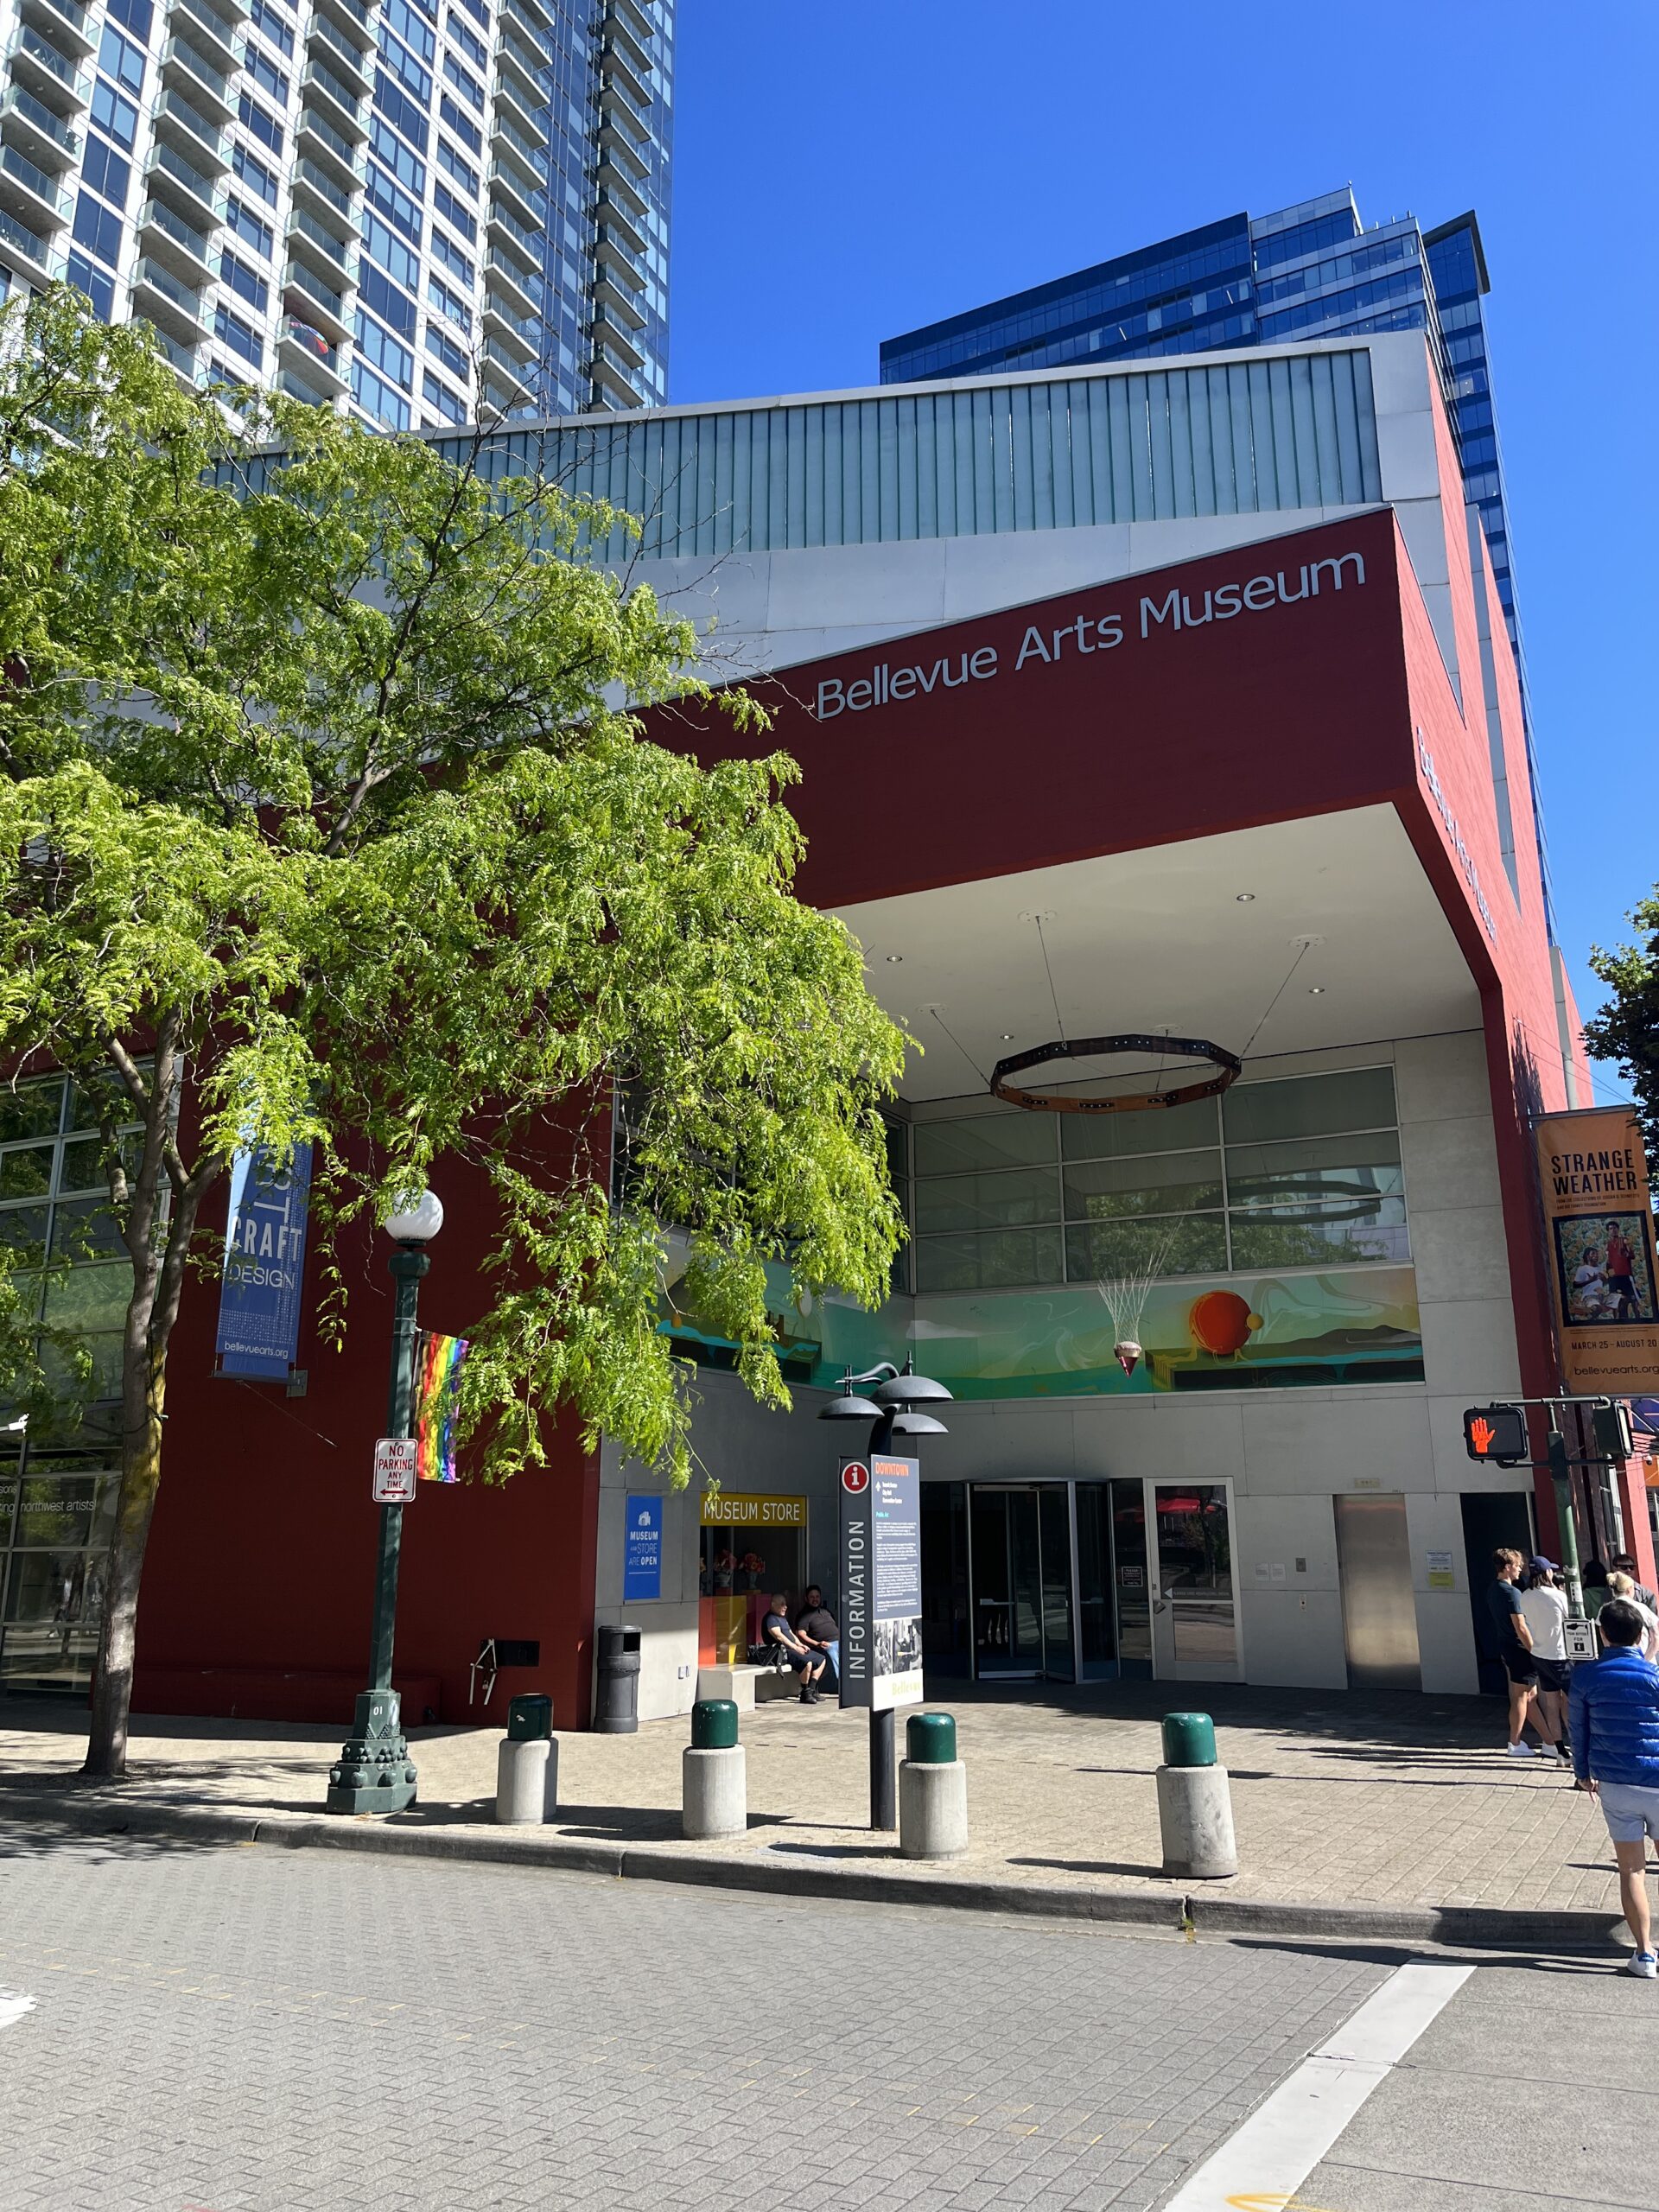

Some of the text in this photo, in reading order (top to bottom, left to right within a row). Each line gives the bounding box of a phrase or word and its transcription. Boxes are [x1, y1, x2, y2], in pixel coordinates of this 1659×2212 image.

[817, 551, 1365, 720] Bellevue Arts Museum
[1551, 1149, 1635, 1175] STRANGE
[1553, 1171, 1637, 1197] WEATHER
[232, 1216, 302, 1262] CRAFT
[229, 1264, 296, 1290] DESIGN
[225, 1340, 289, 1359] bellevuearts.org
[1572, 1341, 1597, 1350] MARCH
[1599, 1340, 1608, 1349] 25
[1617, 1339, 1644, 1348] AUGUST
[1573, 1364, 1659, 1376] bellevuearts.org
[389, 1446, 404, 1456] NO
[378, 1459, 413, 1470] PARKING
[875, 1462, 909, 1477] DOWNTOWN
[20, 1501, 64, 1512] northwest
[66, 1499, 94, 1511] artists
[704, 1501, 800, 1521] MUSEUM STORE
[630, 1531, 658, 1541] MUSEUM
[637, 1542, 657, 1554] STORE
[629, 1556, 658, 1566] ARE OPEN
[849, 1521, 865, 1679] INFORMATION
[373, 1706, 383, 1716] 01
